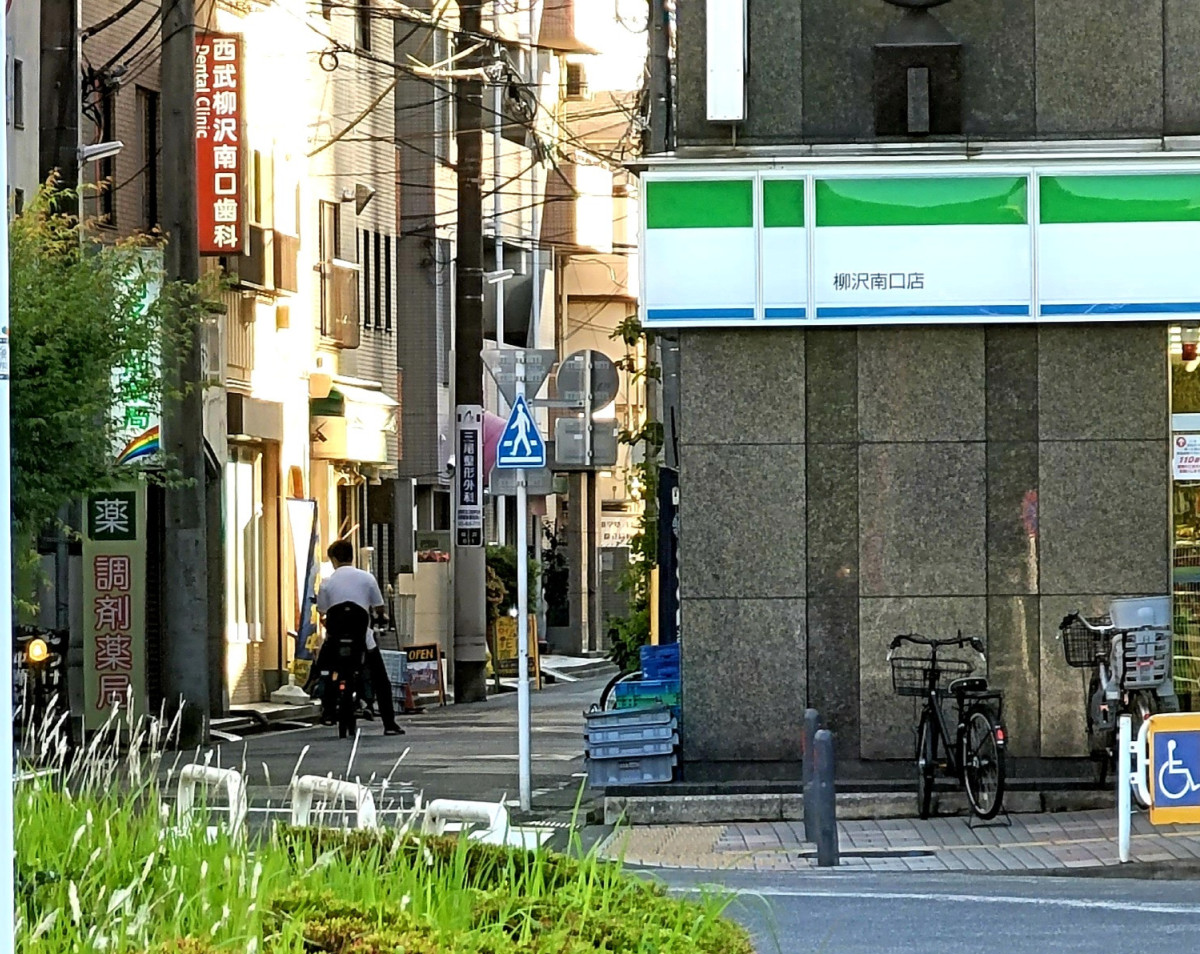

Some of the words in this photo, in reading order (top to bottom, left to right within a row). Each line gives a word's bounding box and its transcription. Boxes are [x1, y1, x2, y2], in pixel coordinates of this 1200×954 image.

[196, 45, 211, 93] Dental
[196, 97, 211, 139] Clinic
[212, 38, 238, 248] 西武柳沢南口歯科
[833, 272, 925, 291] 柳沢南口店
[95, 498, 129, 534] 薬
[95, 555, 133, 711] 調剤薬局
[408, 649, 434, 661] OPEN
